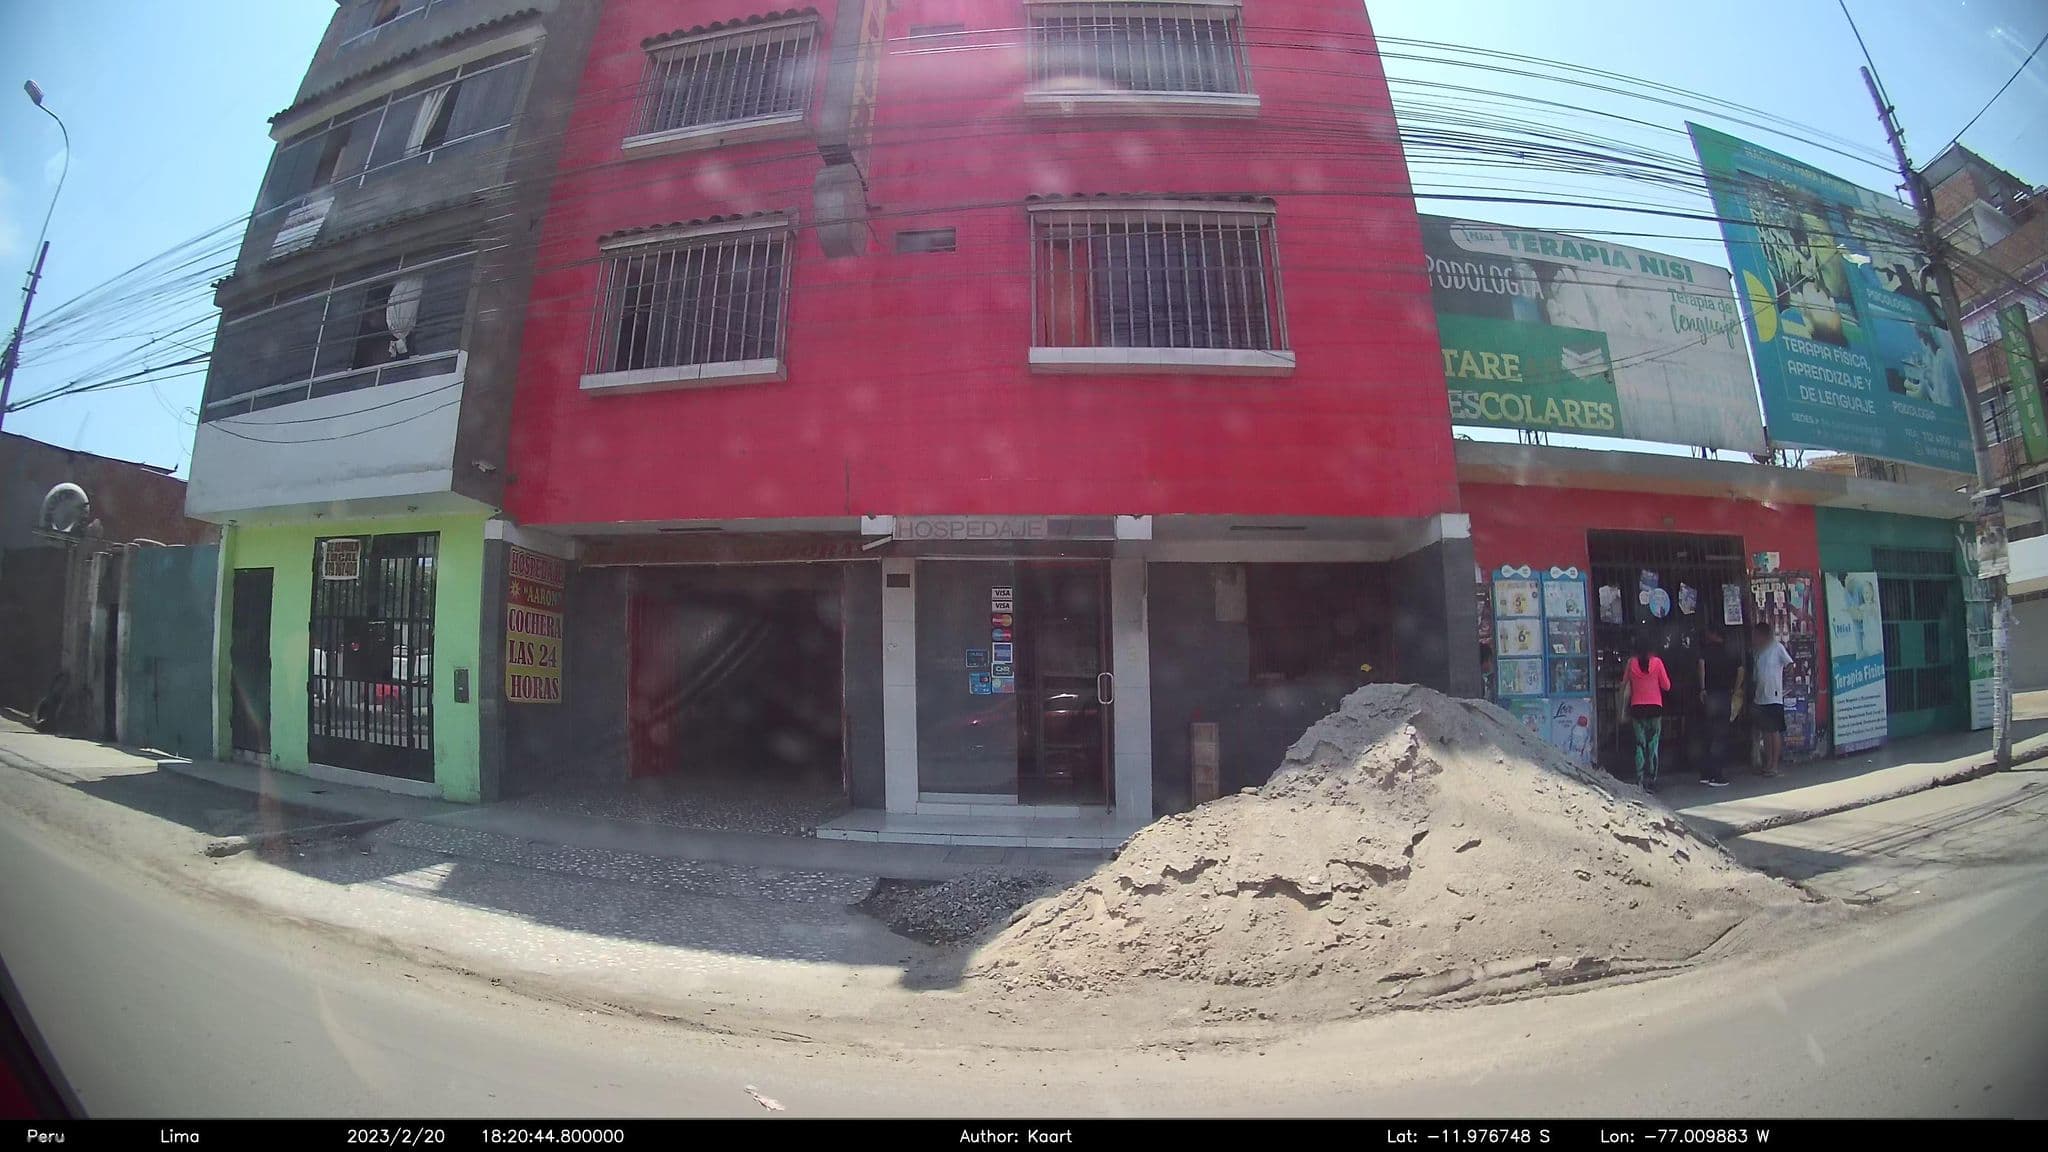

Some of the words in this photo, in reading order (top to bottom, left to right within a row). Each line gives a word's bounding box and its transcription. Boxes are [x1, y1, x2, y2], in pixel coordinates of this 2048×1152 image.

[1503, 230, 1631, 269] TERAPIA
[1638, 254, 1695, 283] NISI
[1667, 287, 1715, 312] Terapia
[1718, 298, 1733, 314] de
[1783, 335, 1833, 362] TERAPIA
[1787, 360, 1863, 391] APRENDIZAJE
[1864, 378, 1872, 392] Y
[1447, 389, 1616, 431] ESCOLARES
[1800, 385, 1819, 402] DE
[1819, 389, 1876, 415] LENGUAJE
[897, 519, 1045, 538] HOSPEDAJE
[509, 608, 562, 639] COCHERA
[509, 639, 534, 666] LAS
[539, 644, 557, 668] 24
[510, 674, 560, 700] HORAS
[1834, 669, 1863, 689] Terapia
